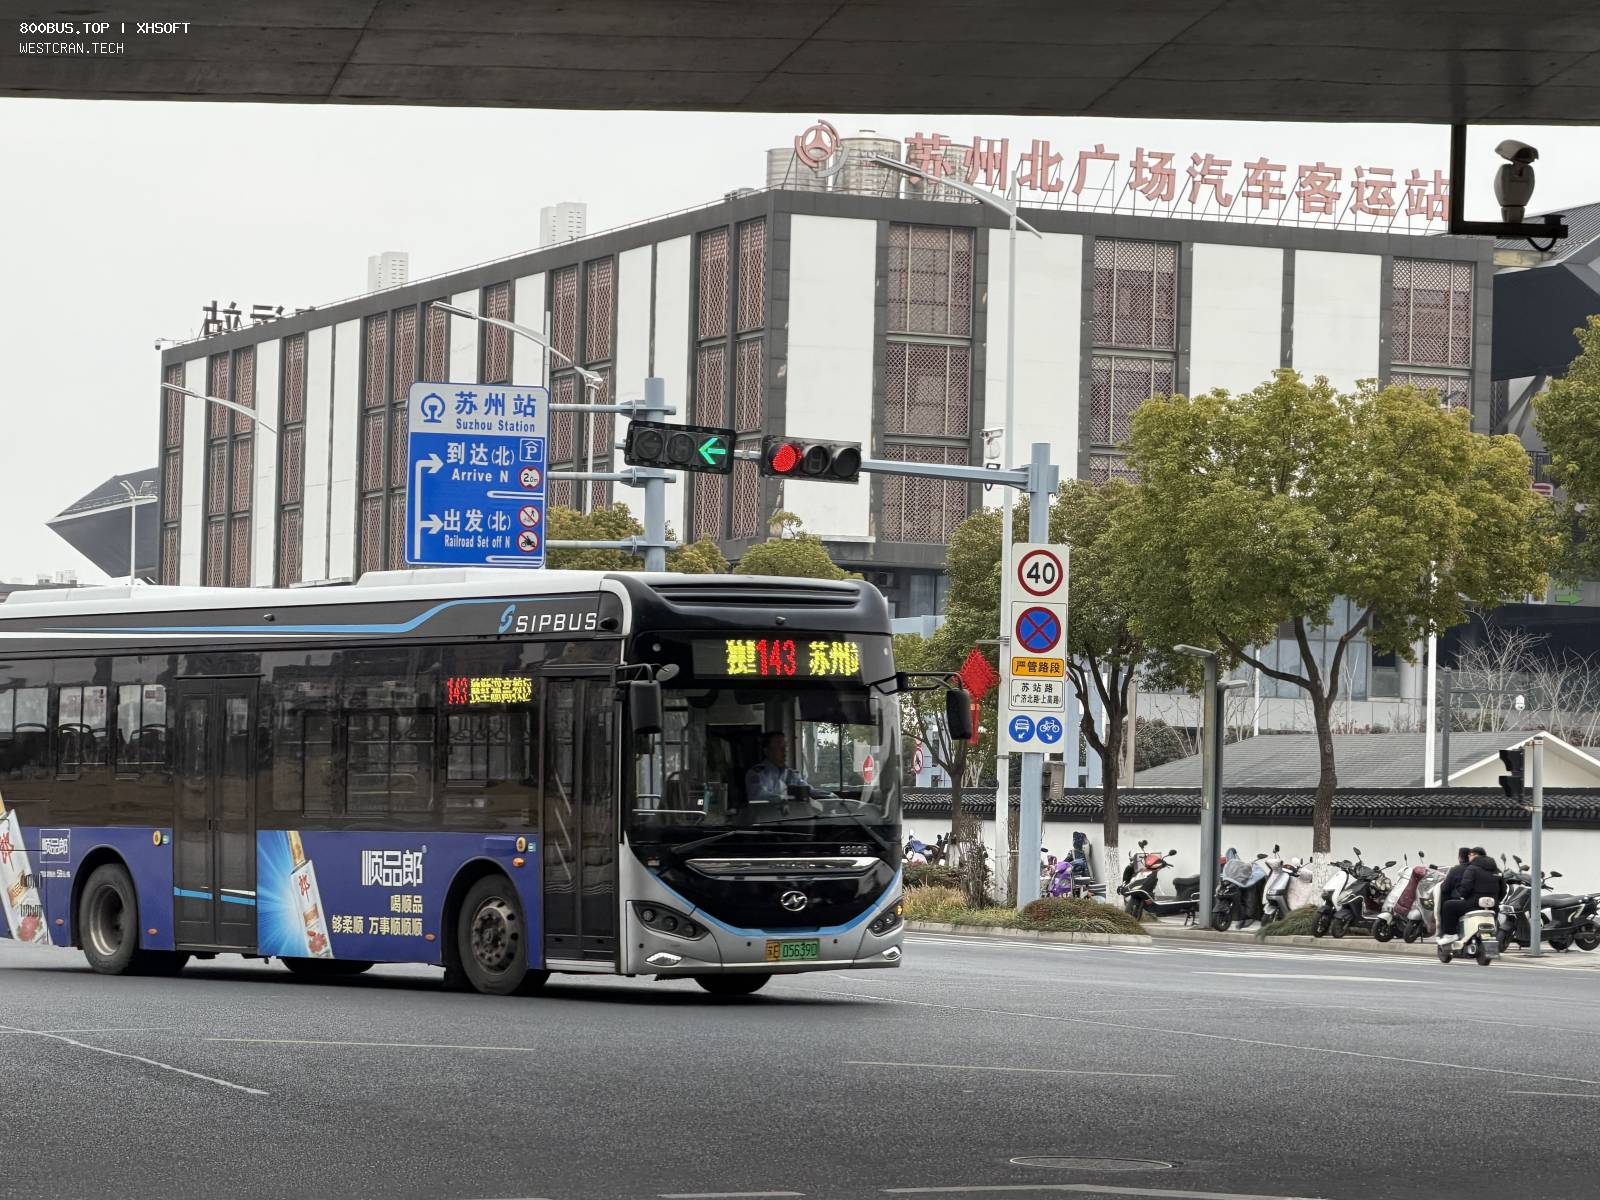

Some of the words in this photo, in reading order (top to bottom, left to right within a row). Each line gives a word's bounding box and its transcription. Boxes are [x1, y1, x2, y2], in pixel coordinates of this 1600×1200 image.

[905, 132, 1449, 221] 苏州北广场汽车客运站
[454, 391, 537, 418] 苏州站
[456, 418, 492, 431] Suzhou
[498, 420, 535, 432] Station
[446, 442, 515, 466] 到达(北)
[452, 468, 493, 483] Arrive
[500, 470, 509, 483] N
[443, 509, 511, 532] 出发(北)
[444, 534, 474, 548] Railroad
[477, 535, 489, 548] Set
[492, 536, 502, 548] off
[505, 536, 511, 548] N
[1026, 562, 1056, 585] 40
[515, 612, 598, 633] SIPBUS
[755, 639, 798, 676] 143
[1015, 660, 1061, 675] 严管路段
[1021, 682, 1053, 693] 苏站路
[361, 849, 423, 888] 顺品郎
[390, 894, 423, 914] 喝顺品
[331, 914, 364, 935] 够柔顺
[368, 916, 423, 937] 万事顺顺顺
